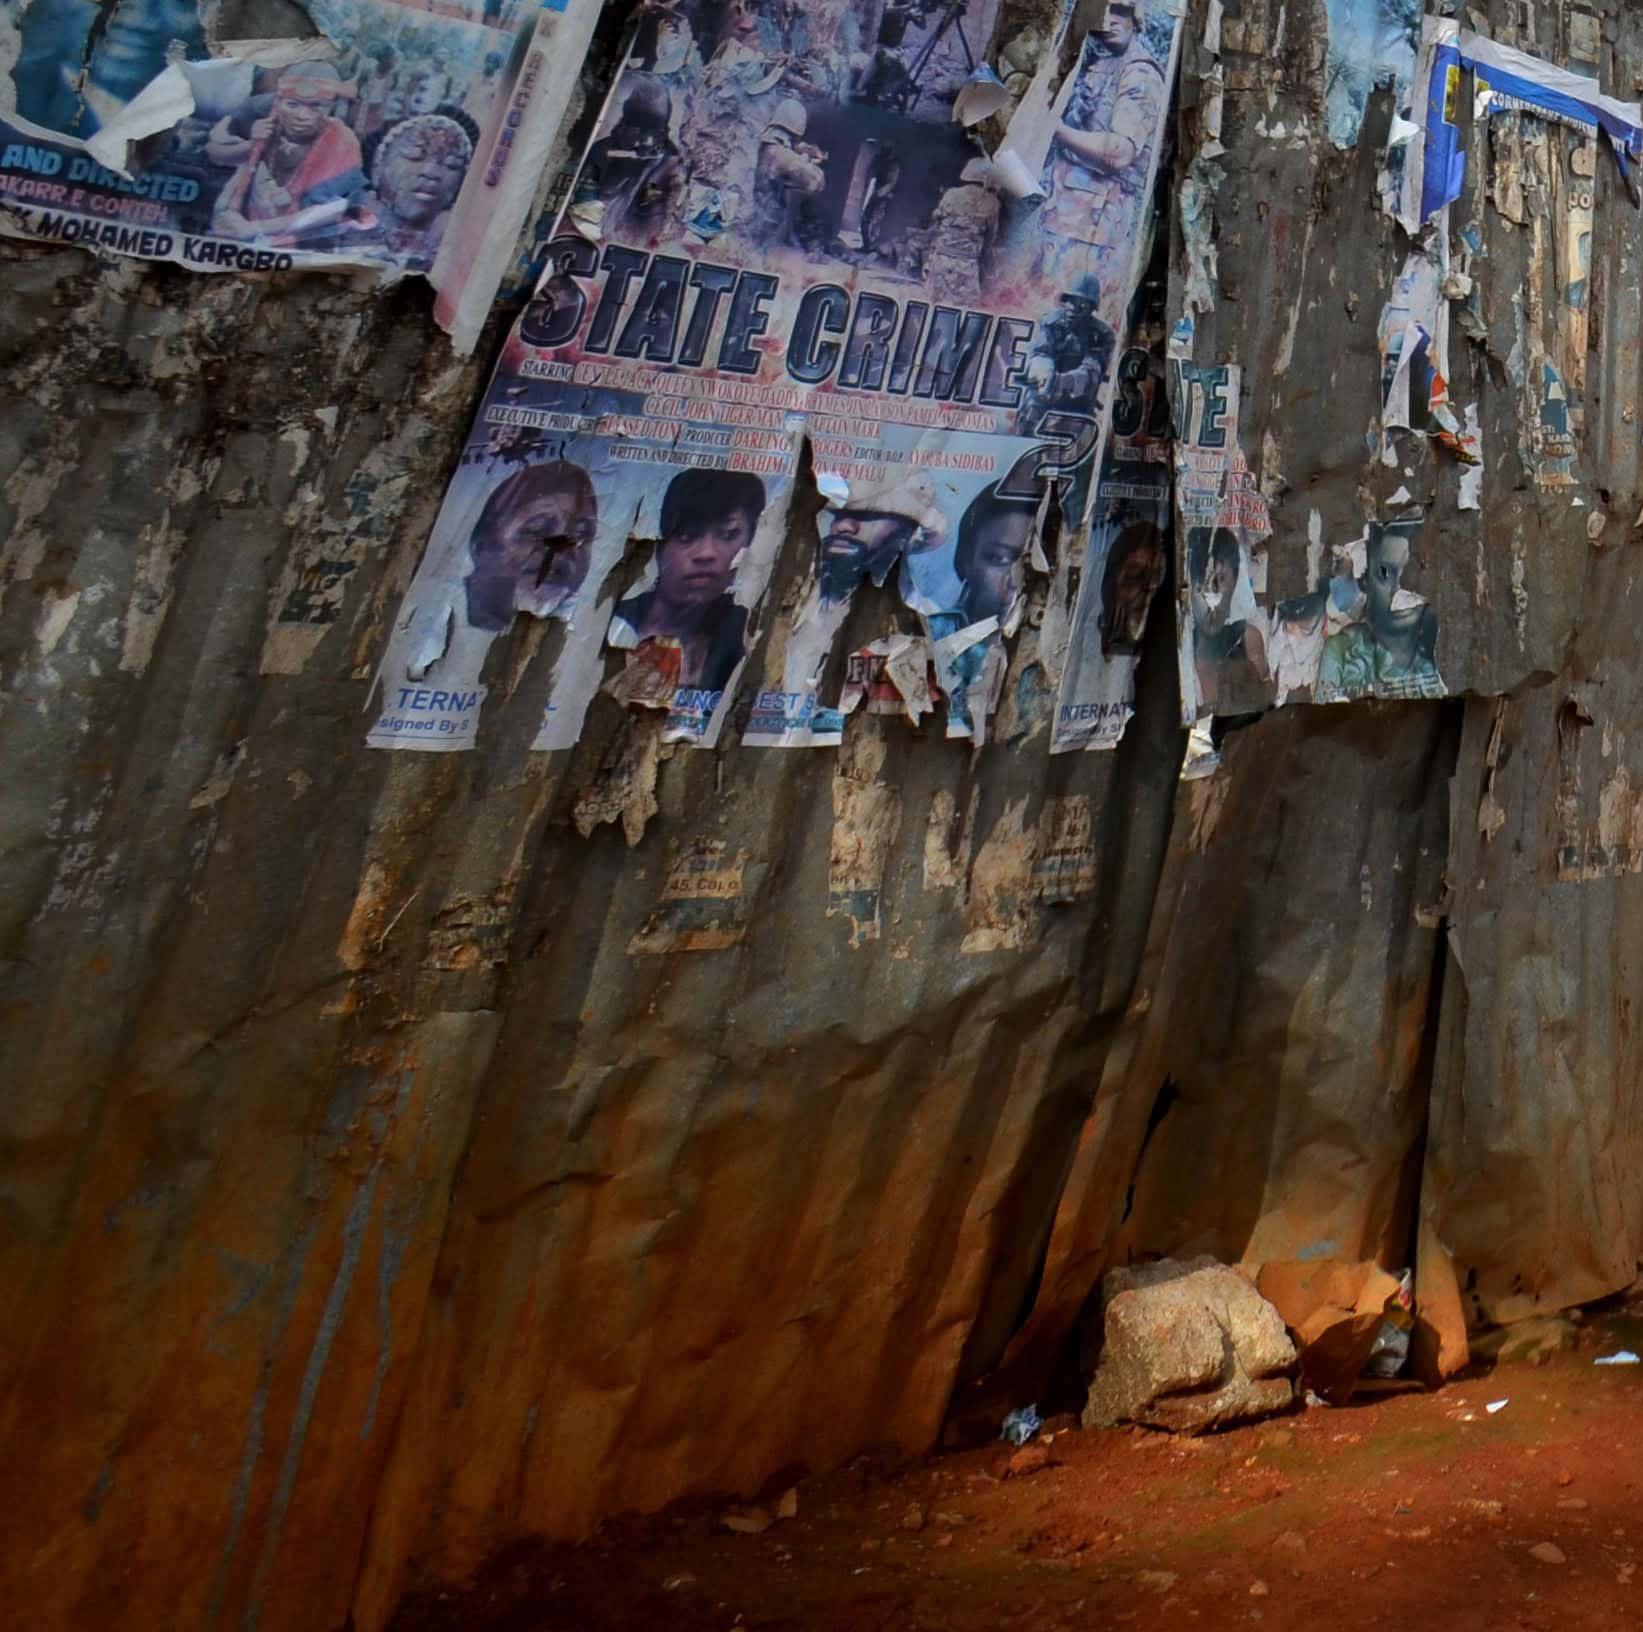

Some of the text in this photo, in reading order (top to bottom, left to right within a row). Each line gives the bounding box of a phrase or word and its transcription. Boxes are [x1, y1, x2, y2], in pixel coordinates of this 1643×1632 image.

[2, 144, 63, 176] AND
[36, 213, 174, 257] MOHAMED
[183, 237, 294, 272] KARGBO
[520, 235, 1035, 409] STATE CRIME
[521, 359, 574, 382] STARRING
[719, 403, 754, 426] TIGER
[812, 416, 850, 436] APTAIN
[997, 410, 1099, 501] 2
